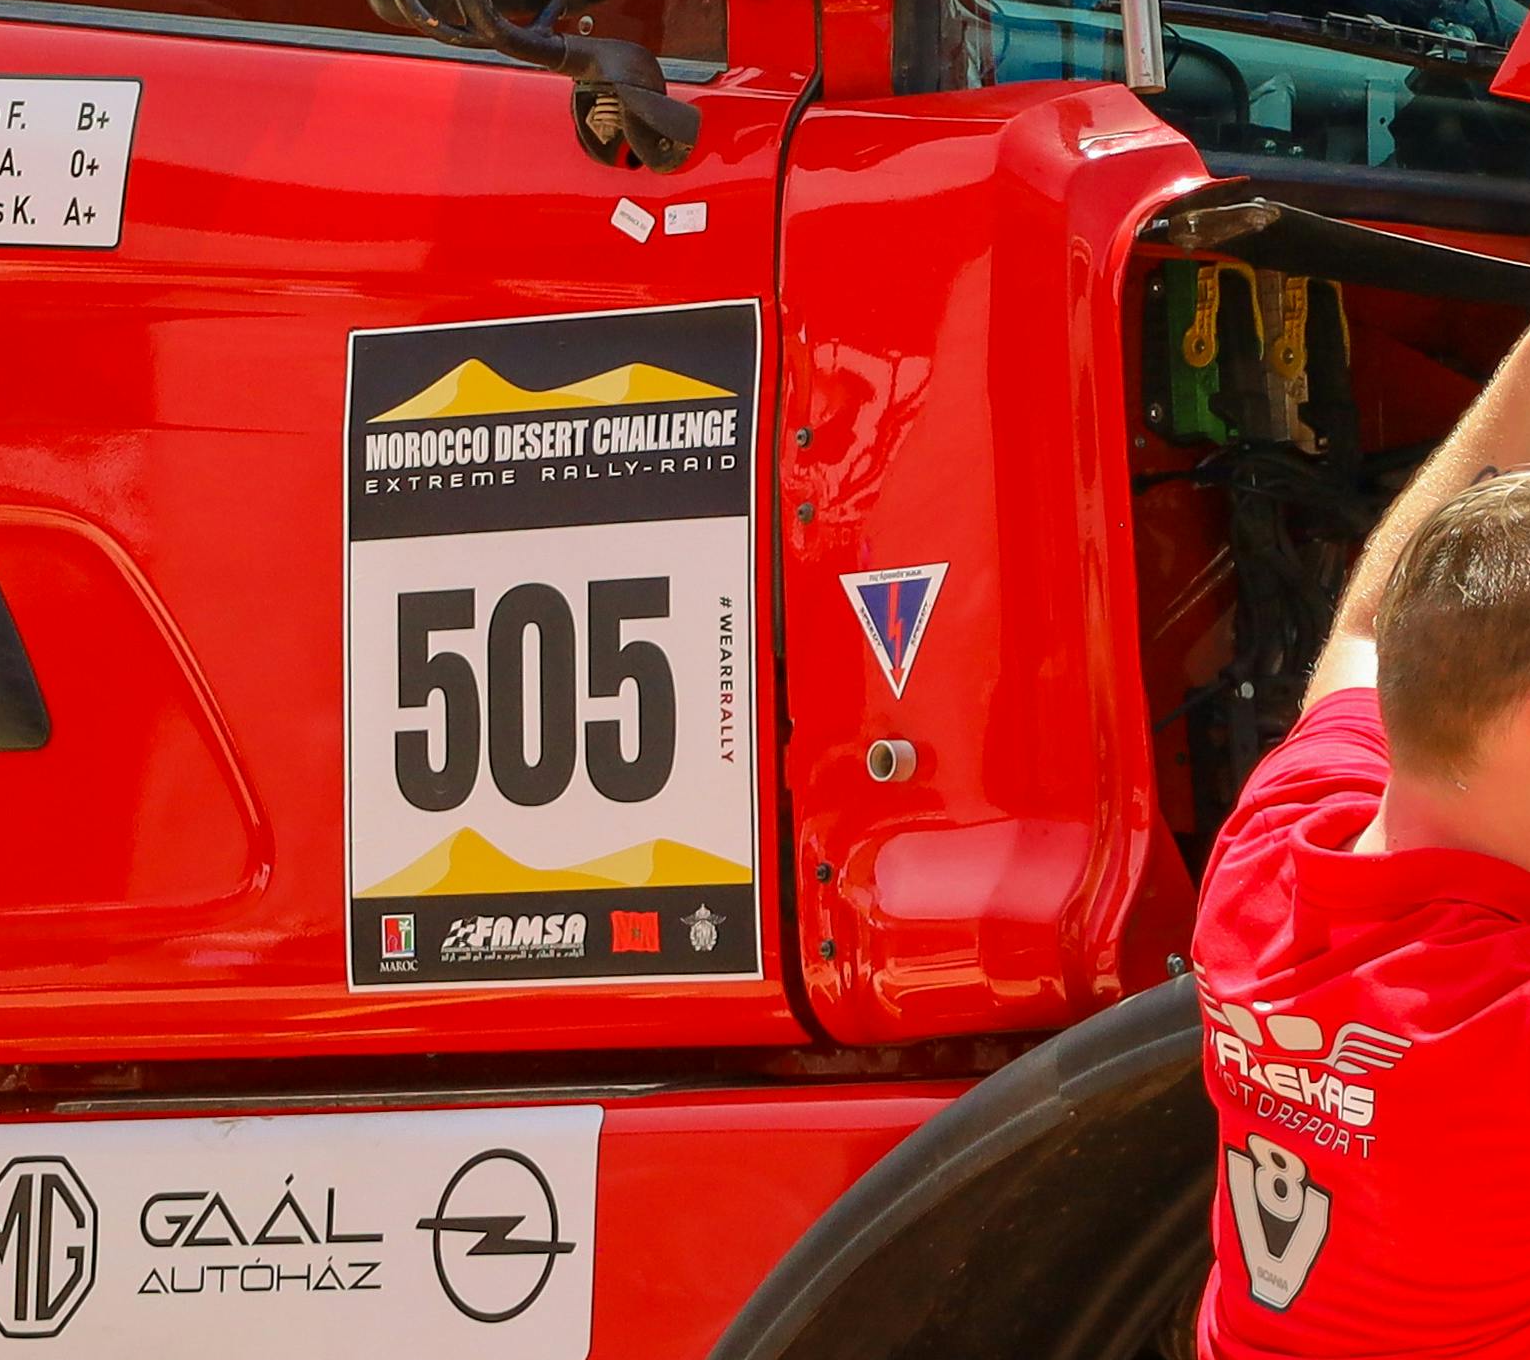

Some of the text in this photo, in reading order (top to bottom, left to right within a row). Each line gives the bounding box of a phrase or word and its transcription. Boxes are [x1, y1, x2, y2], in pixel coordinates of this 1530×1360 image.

[7, 101, 27, 130] F.
[77, 102, 110, 131] B+
[12, 195, 36, 225] K.
[63, 197, 97, 226] A+
[366, 409, 738, 471] MOROCCO DESERT CHALLENGE
[366, 455, 737, 494] EXTREME RALLY-RAID
[395, 576, 676, 812] 505
[471, 913, 587, 947] FAMSA
[380, 959, 419, 973] MAROC
[1211, 1026, 1374, 1127] AZEKAS
[1214, 1062, 1376, 1159] OTORSPORT
[140, 1173, 384, 1248] GAÁL
[137, 1255, 382, 1294] AUTÓHÁZ
